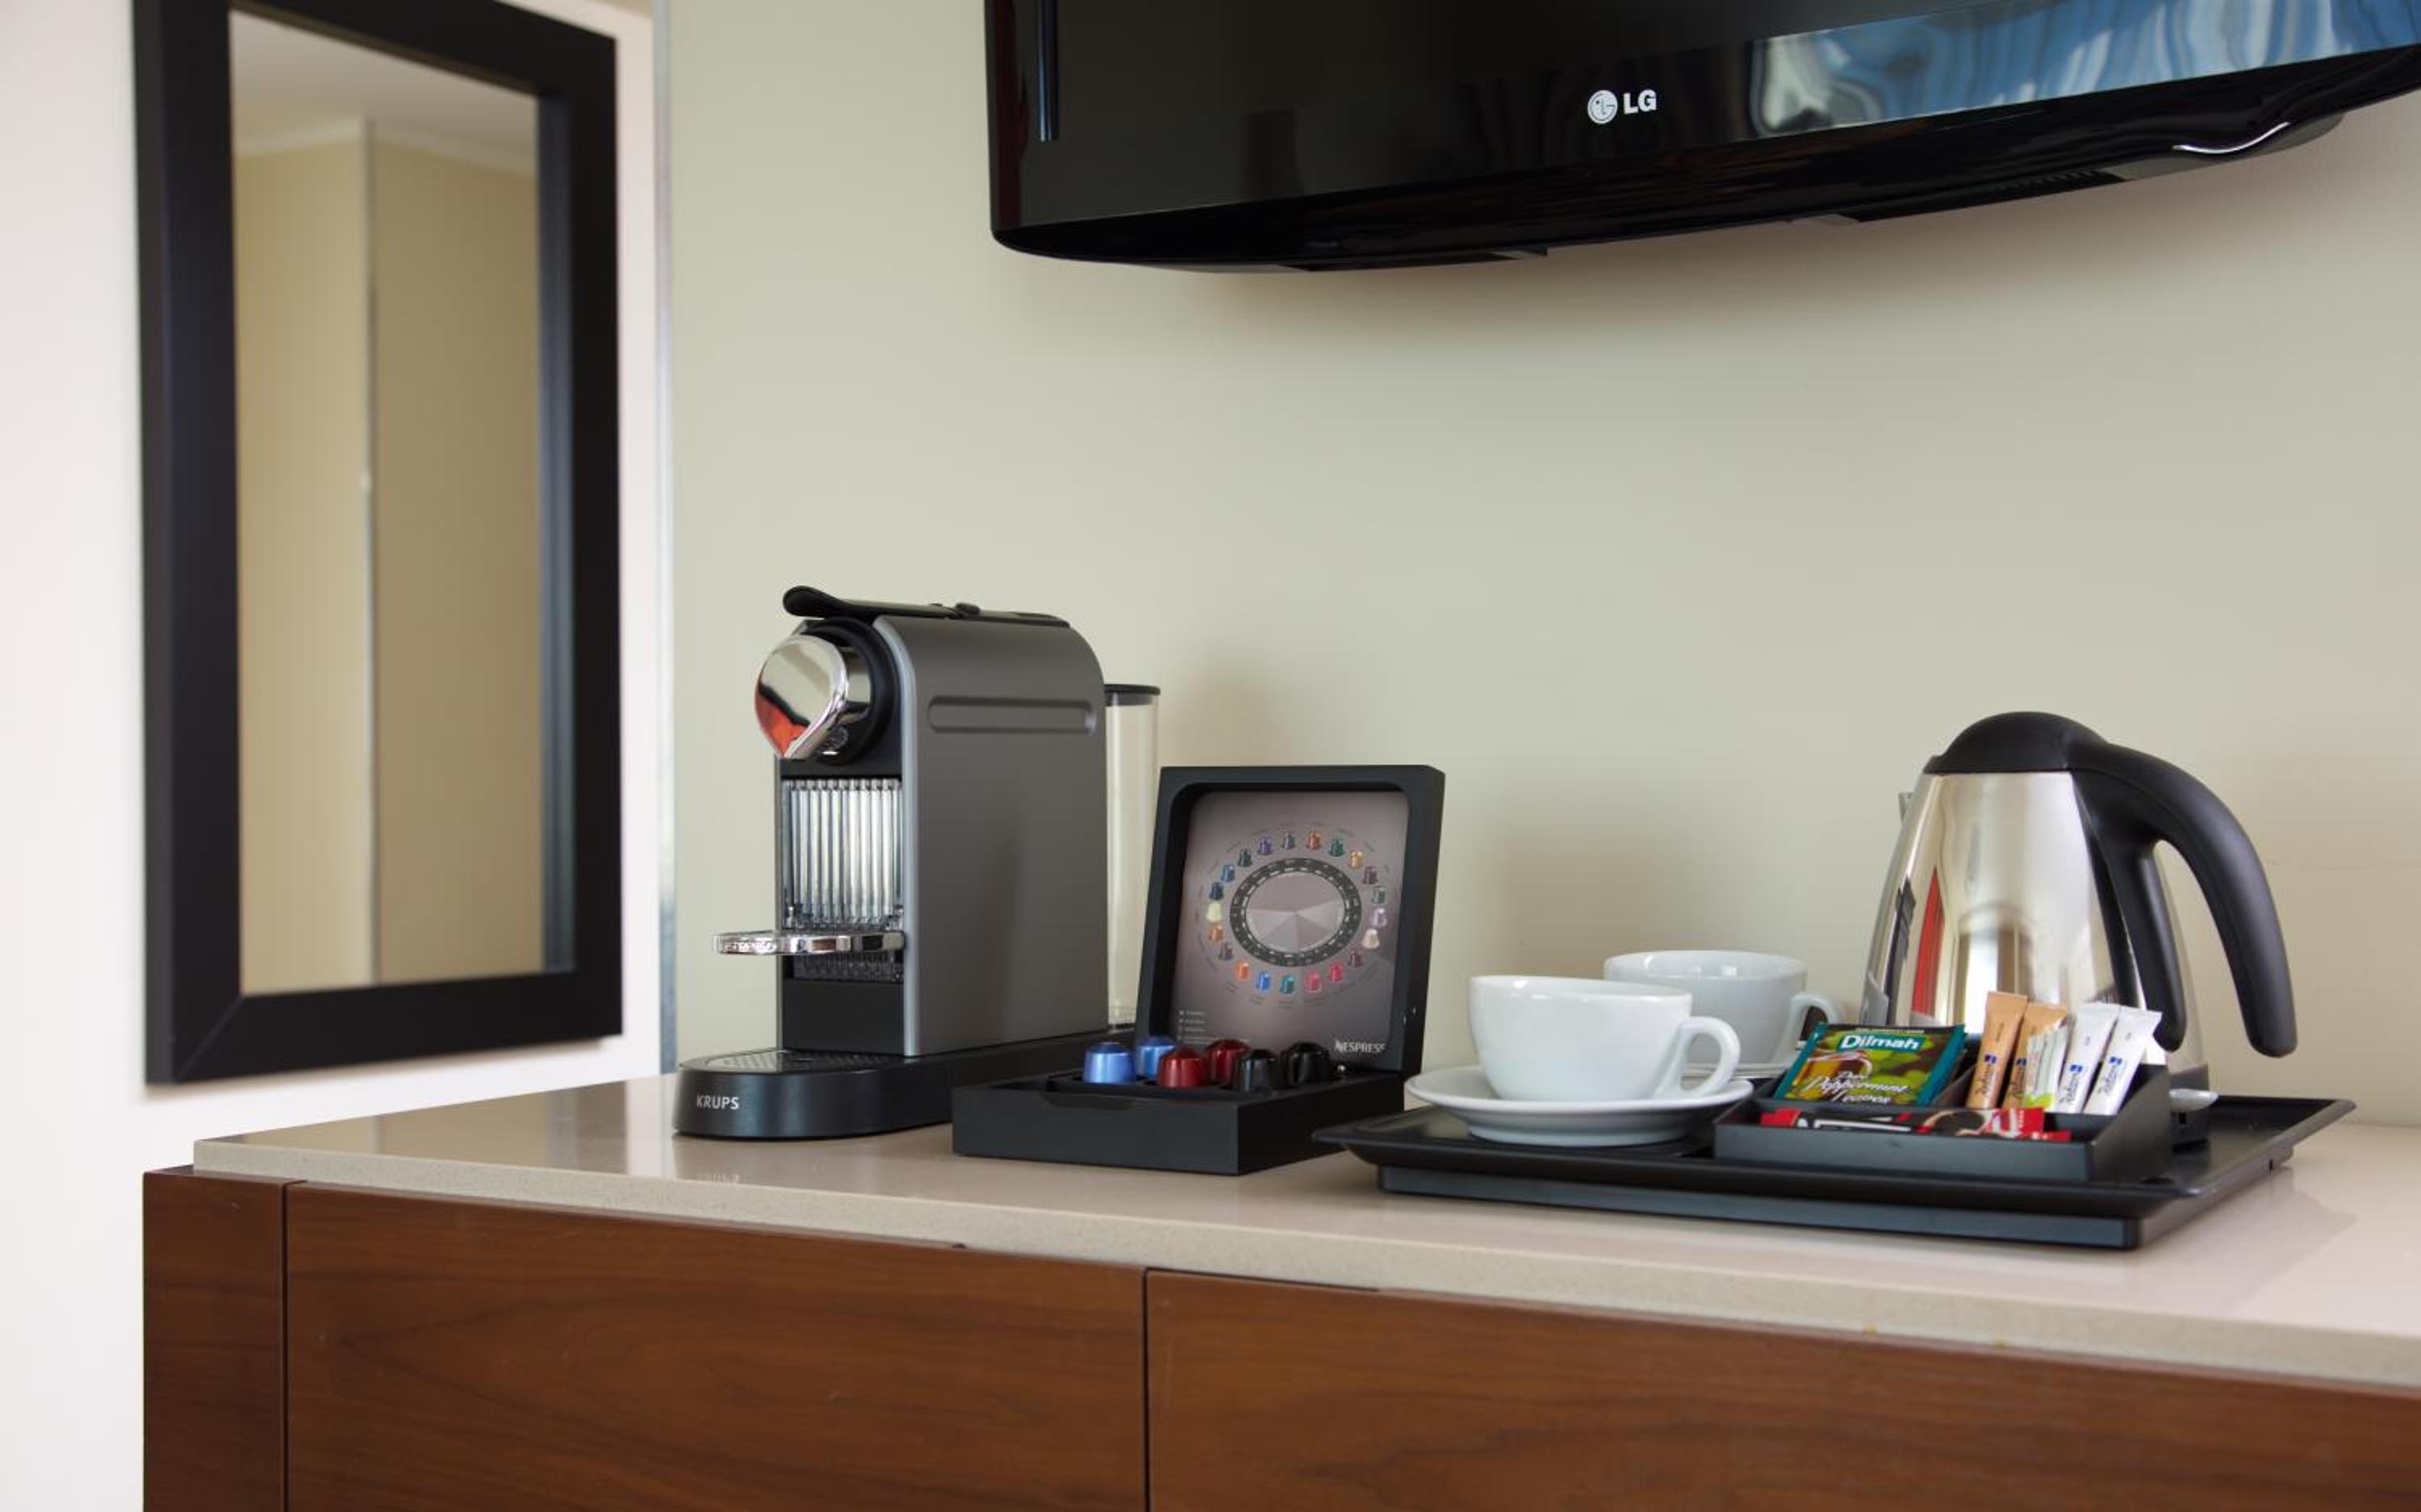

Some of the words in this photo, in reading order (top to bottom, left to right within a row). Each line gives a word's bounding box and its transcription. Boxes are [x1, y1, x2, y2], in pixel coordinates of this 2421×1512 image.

[1623, 90, 1657, 115] LG
[1840, 1034, 1920, 1050] Dilmah
[696, 1094, 739, 1109] KRUPS
